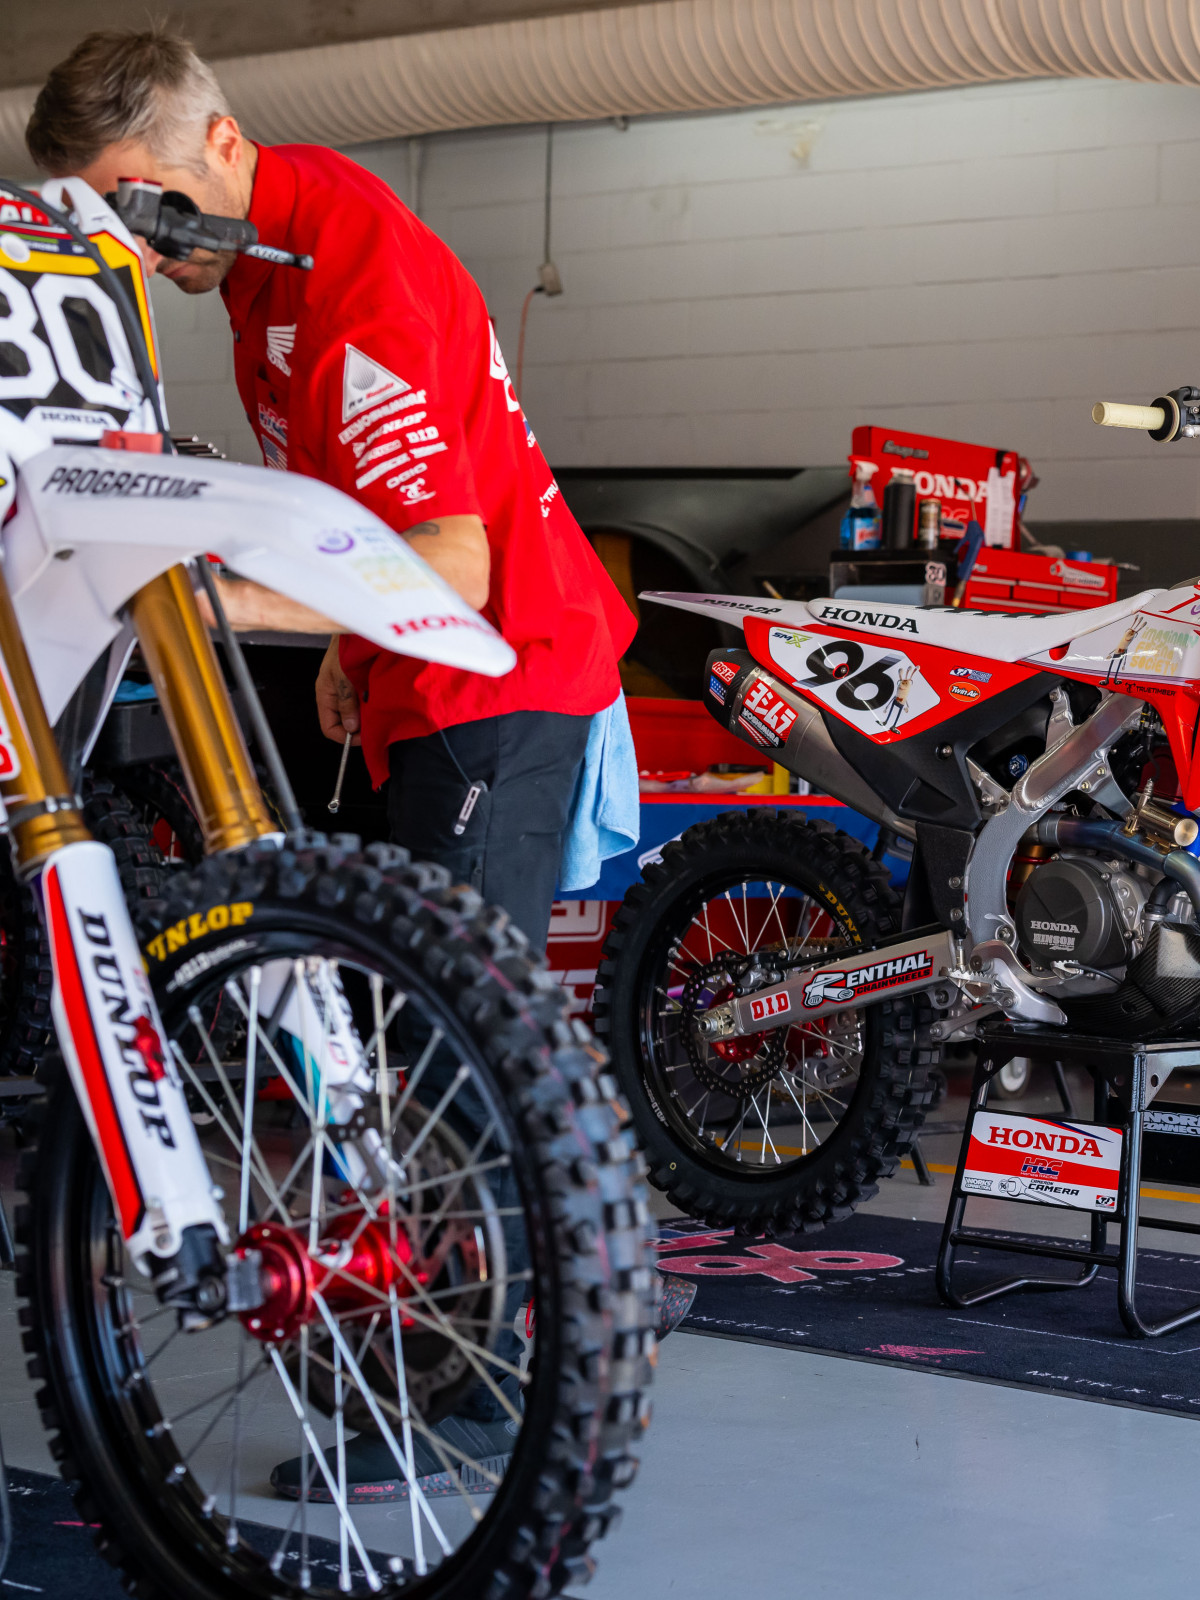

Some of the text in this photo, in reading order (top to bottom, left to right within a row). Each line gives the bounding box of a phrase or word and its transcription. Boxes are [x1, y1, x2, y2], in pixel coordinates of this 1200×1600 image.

[40, 411, 109, 425] HONDA
[818, 605, 919, 634] HONDA
[793, 641, 904, 711] 96
[951, 686, 979, 698] Twin Air
[741, 707, 780, 748] YOSHIMURA
[825, 890, 862, 945] DUNL
[1030, 920, 1081, 934] HONDA
[1033, 933, 1076, 946] HINSON
[857, 968, 931, 995] CHAINWHEELS
[752, 992, 789, 1020] D.I.D
[77, 906, 177, 1150] DUNLOP
[987, 1126, 1103, 1158] HONDA
[1021, 1157, 1064, 1176] HRC
[1028, 1183, 1080, 1196] CAMERA
[354, 1485, 384, 1494] adidas
